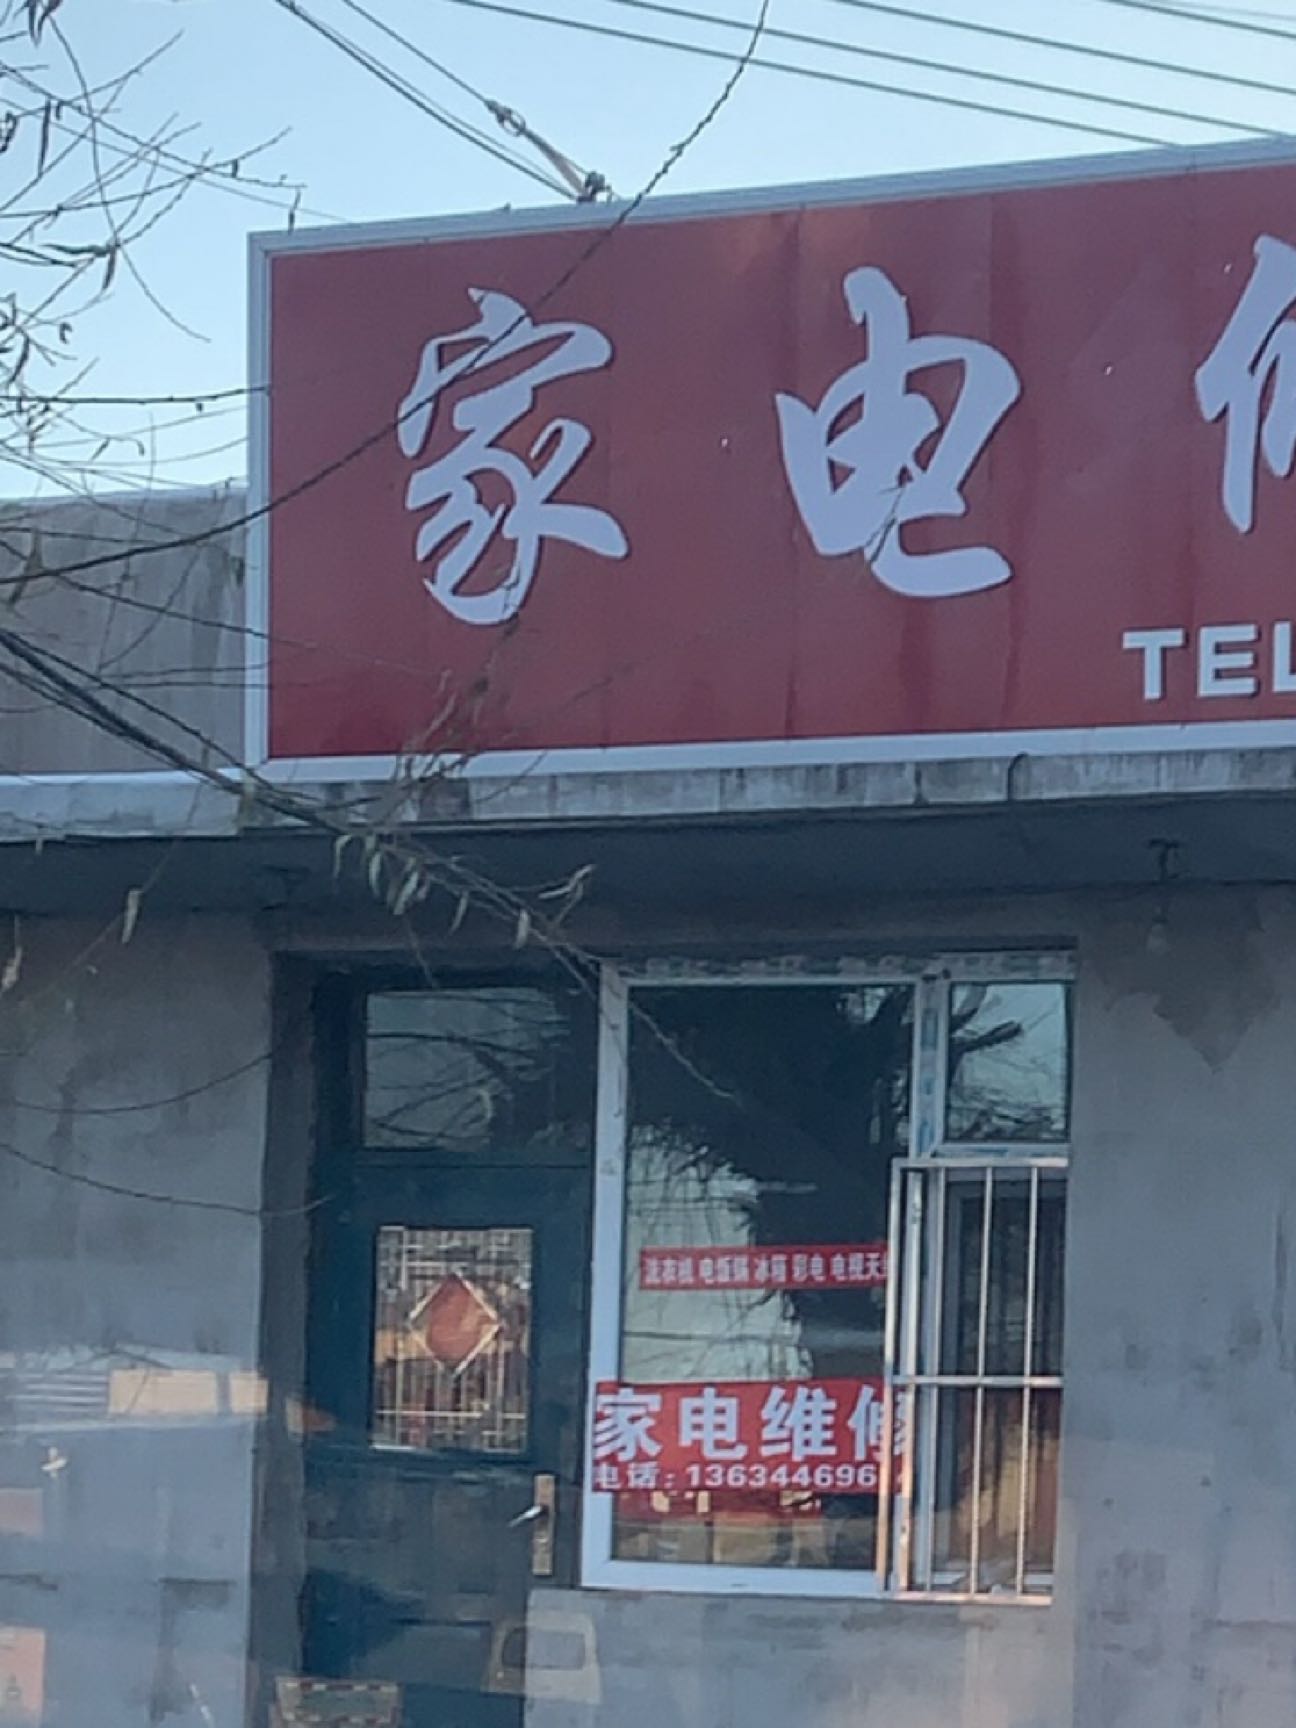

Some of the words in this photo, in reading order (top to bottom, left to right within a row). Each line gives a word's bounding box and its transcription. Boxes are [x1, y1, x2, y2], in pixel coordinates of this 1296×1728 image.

[832, 1252, 890, 1281] 电视天
[595, 1460, 904, 1490] 电话:136344696
